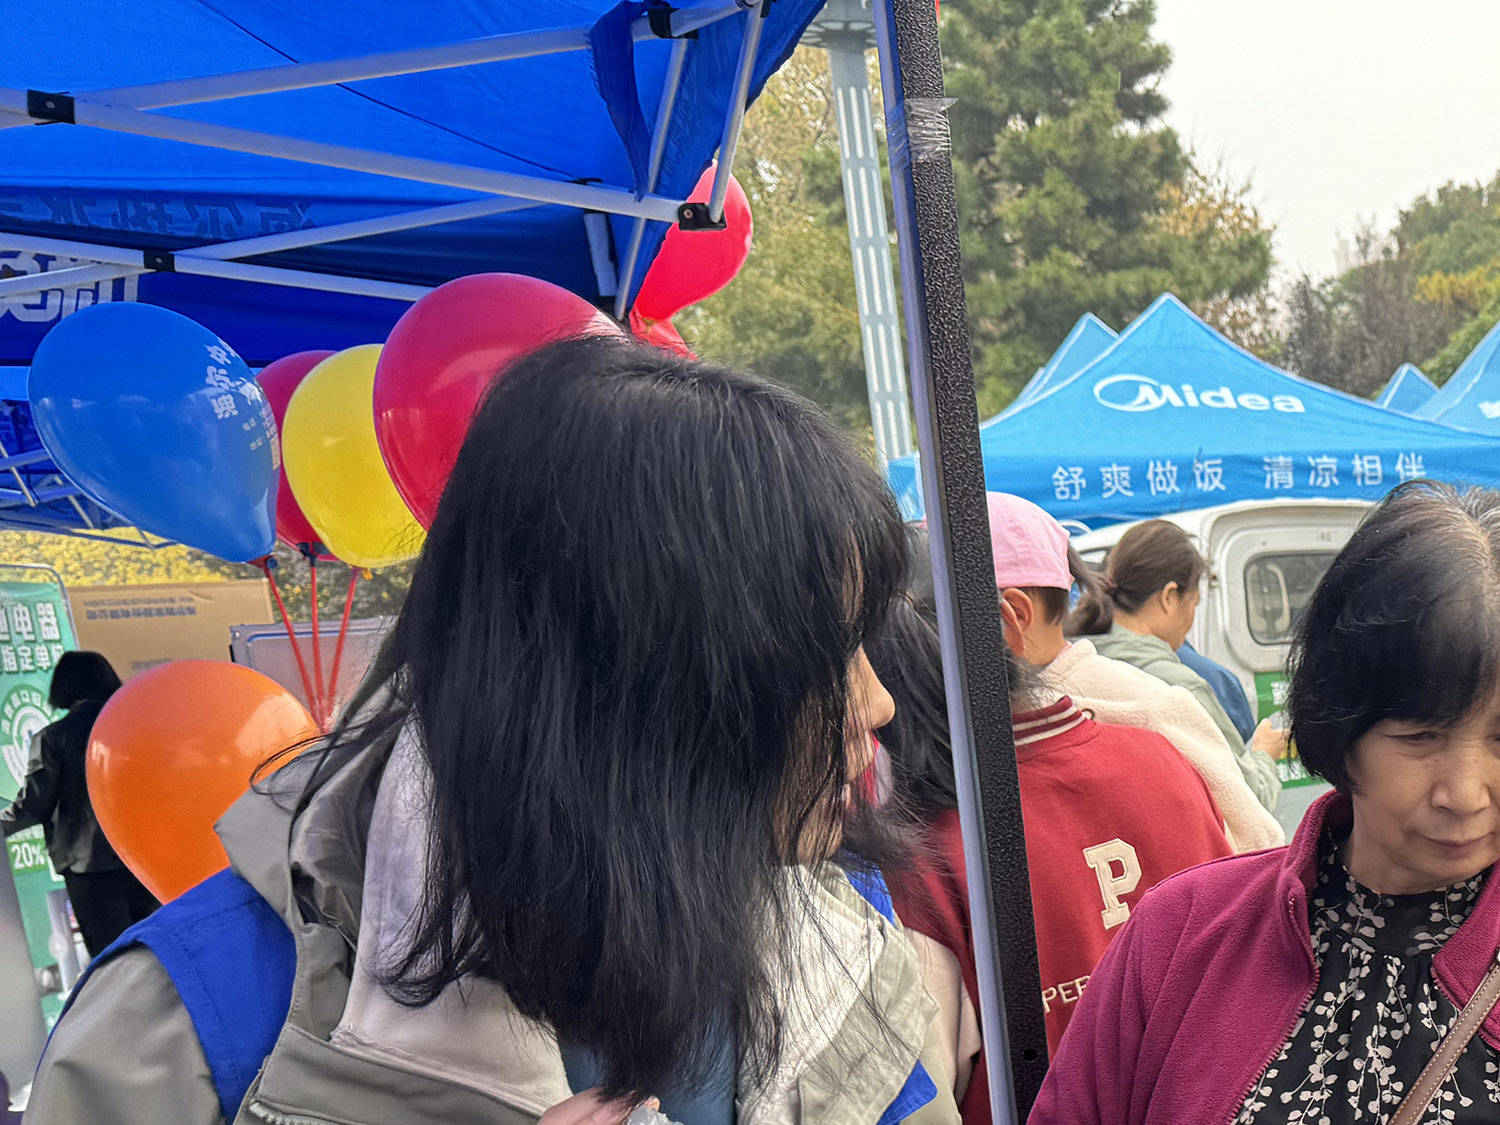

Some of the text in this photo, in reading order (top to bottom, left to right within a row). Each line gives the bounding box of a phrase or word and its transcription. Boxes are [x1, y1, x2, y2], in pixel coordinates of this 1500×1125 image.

[1093, 374, 1306, 413] Midea
[1051, 452, 1427, 501] 舒爽做饭 清凉相伴
[11, 842, 45, 869] 20%
[1083, 838, 1142, 930] P
